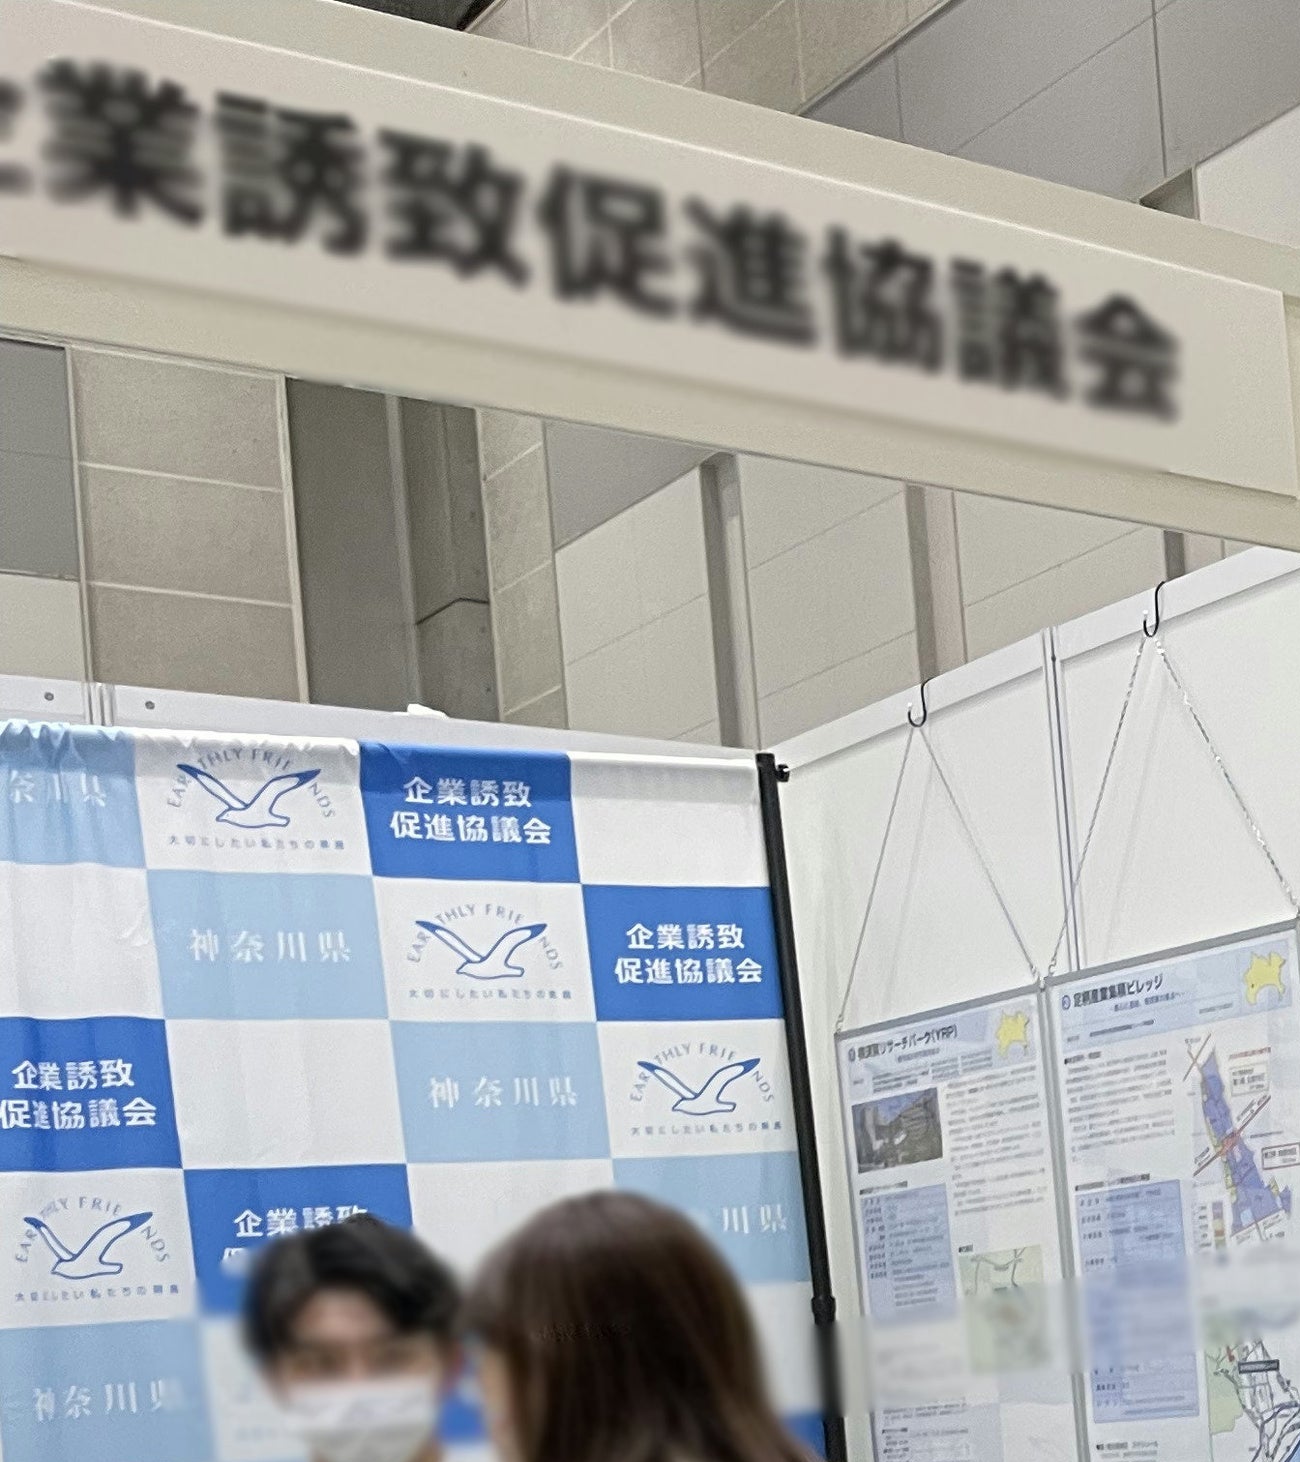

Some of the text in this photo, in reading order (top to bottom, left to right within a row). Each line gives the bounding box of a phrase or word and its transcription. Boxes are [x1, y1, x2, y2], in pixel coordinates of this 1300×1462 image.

[0, 58, 1180, 422] 業誘致促進協議会
[403, 776, 532, 808] 企業誘致
[390, 810, 552, 845] 促進協議会
[186, 929, 350, 962] 神奈川県
[626, 923, 745, 951] 企業誘致
[614, 957, 763, 986] 促進協議会
[12, 1059, 135, 1091] 企業誘致
[429, 1076, 578, 1109] 神奈川県
[0, 1096, 157, 1130] 促進協議会
